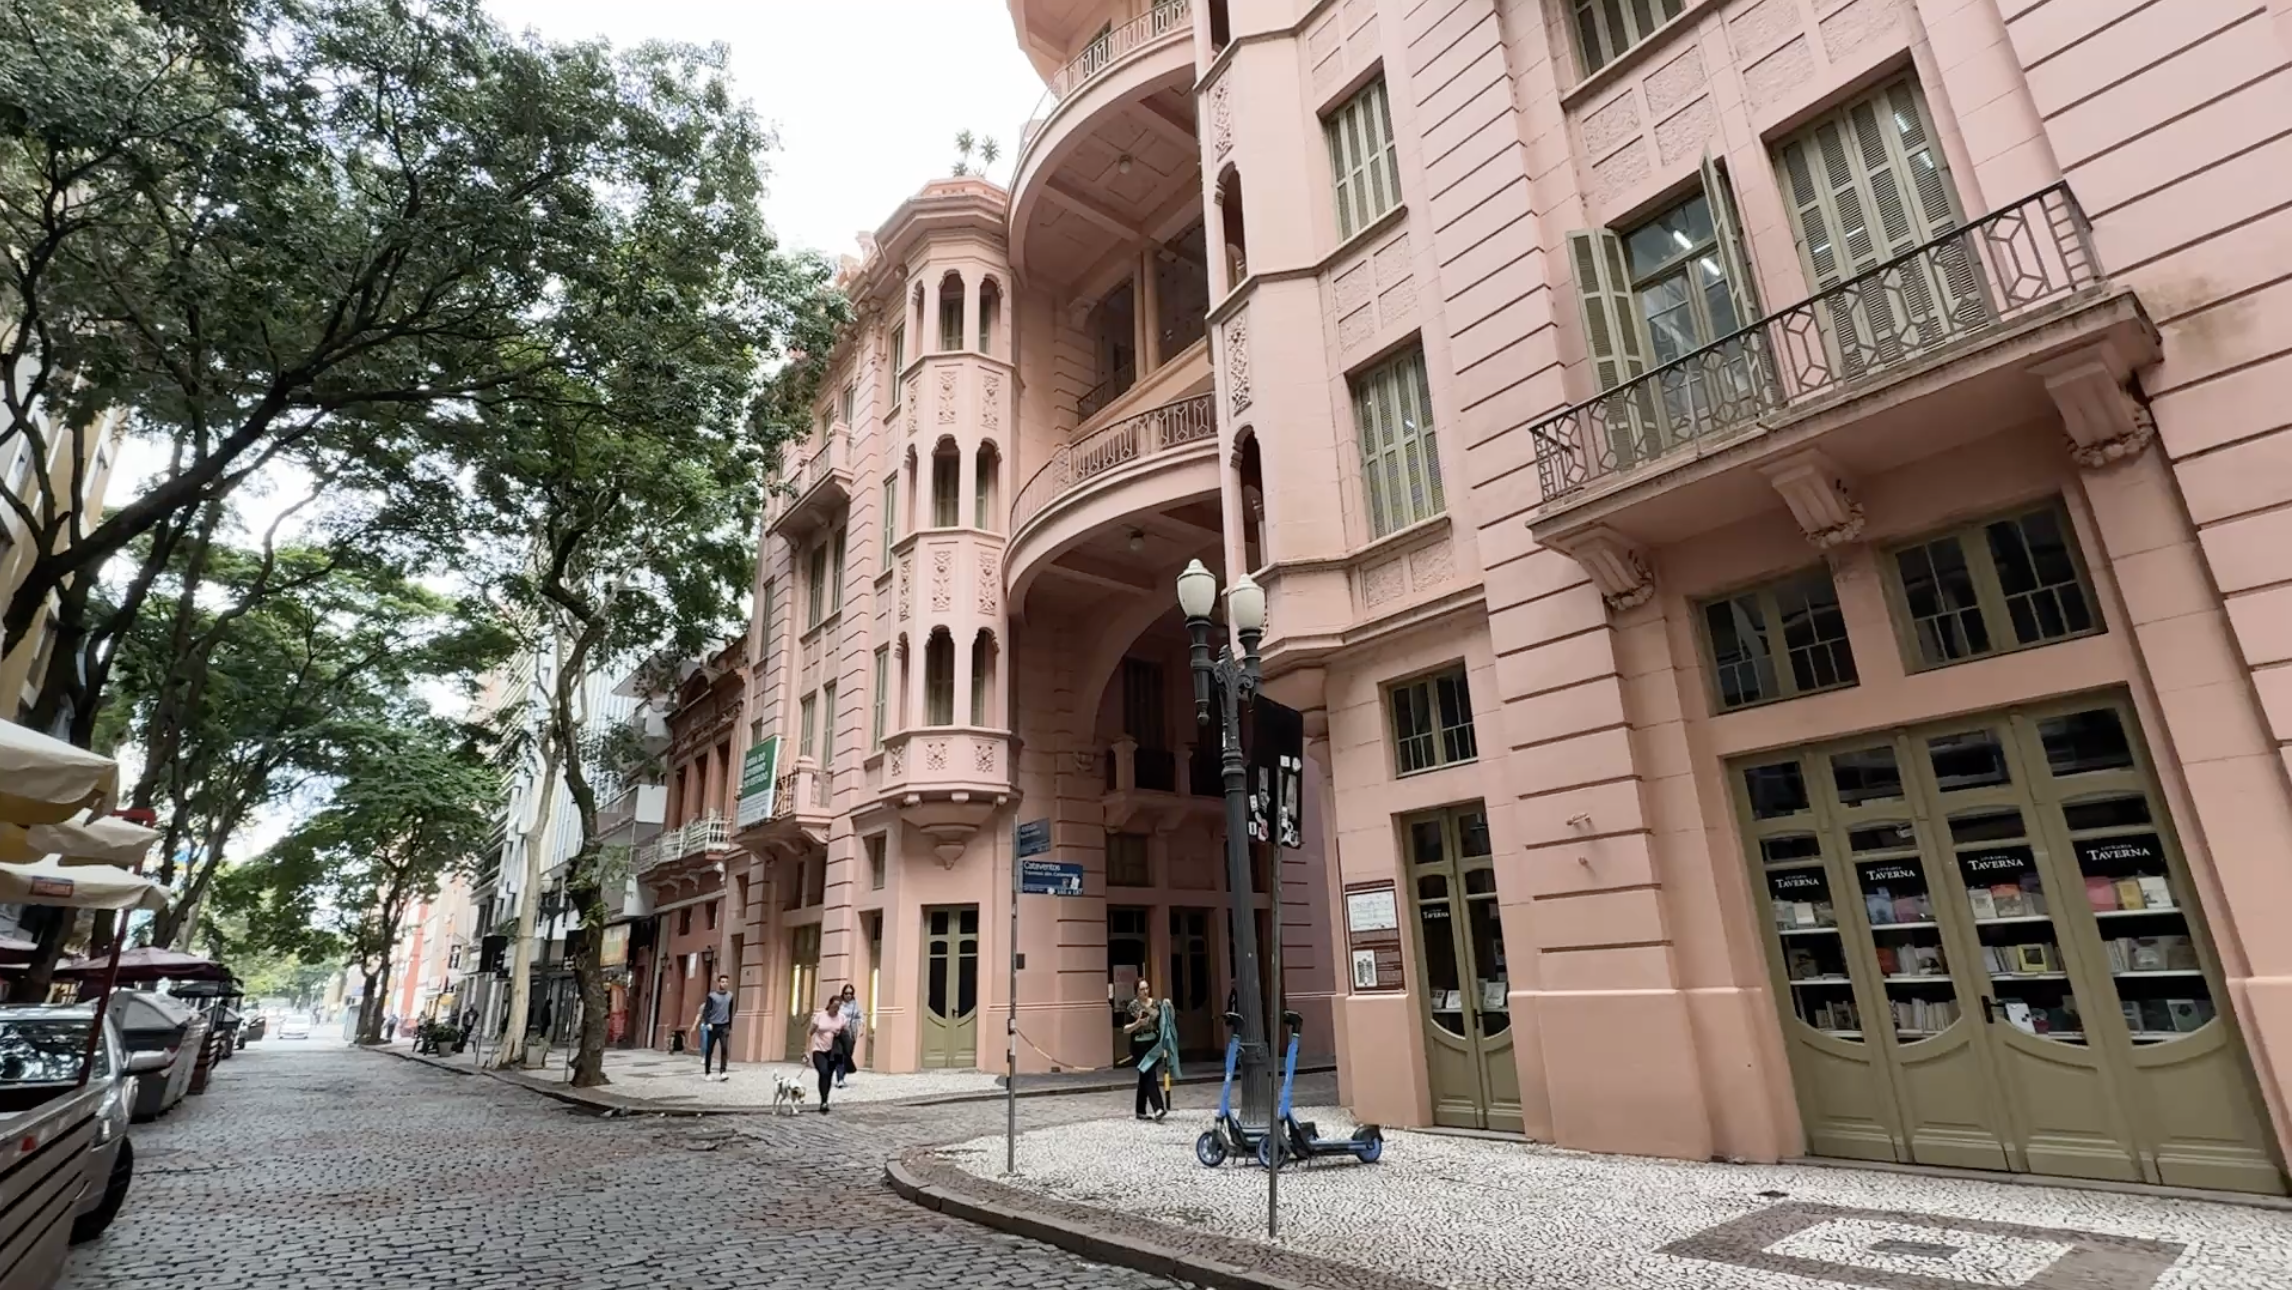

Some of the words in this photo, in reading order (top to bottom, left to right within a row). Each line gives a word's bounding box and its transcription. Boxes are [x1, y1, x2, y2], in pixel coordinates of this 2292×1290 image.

[2086, 848, 2151, 861] TAVERNA
[1967, 859, 2024, 870] TAVERNA
[1866, 870, 1916, 880] TAVERNA
[1775, 878, 1820, 888] TAVERNA
